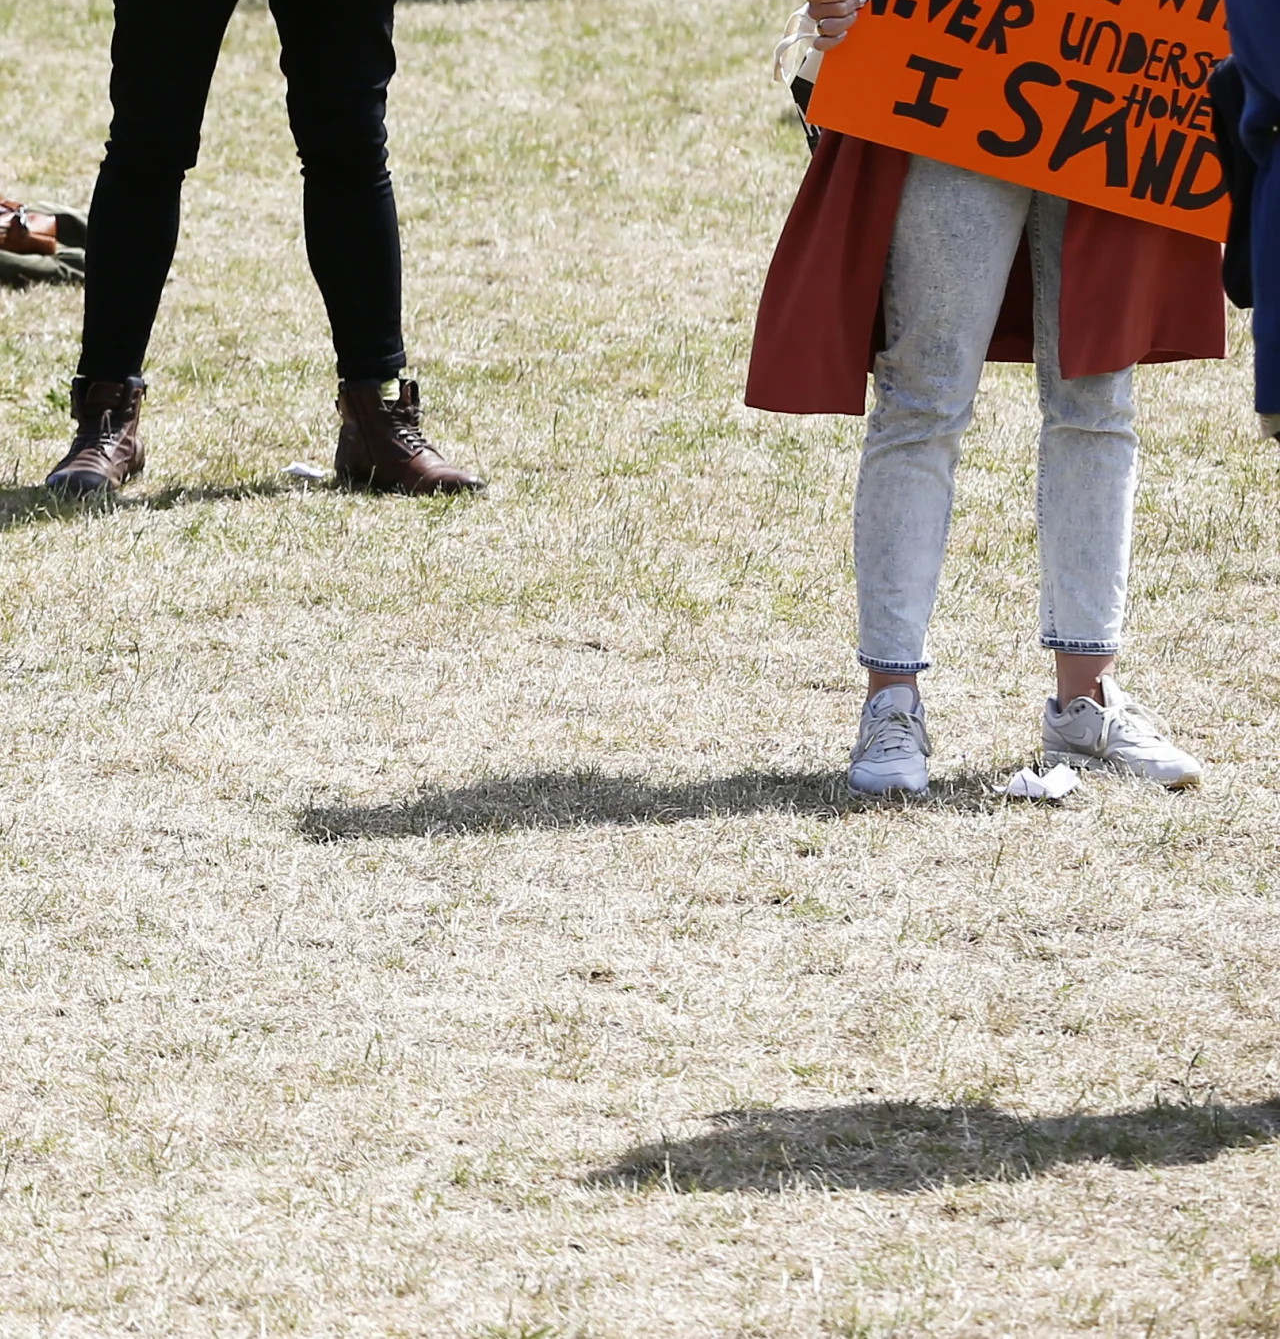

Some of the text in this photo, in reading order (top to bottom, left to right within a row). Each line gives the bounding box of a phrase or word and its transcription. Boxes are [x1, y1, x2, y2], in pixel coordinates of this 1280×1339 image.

[892, 54, 1230, 211] I STAND
[1122, 84, 1214, 133] HOWE
